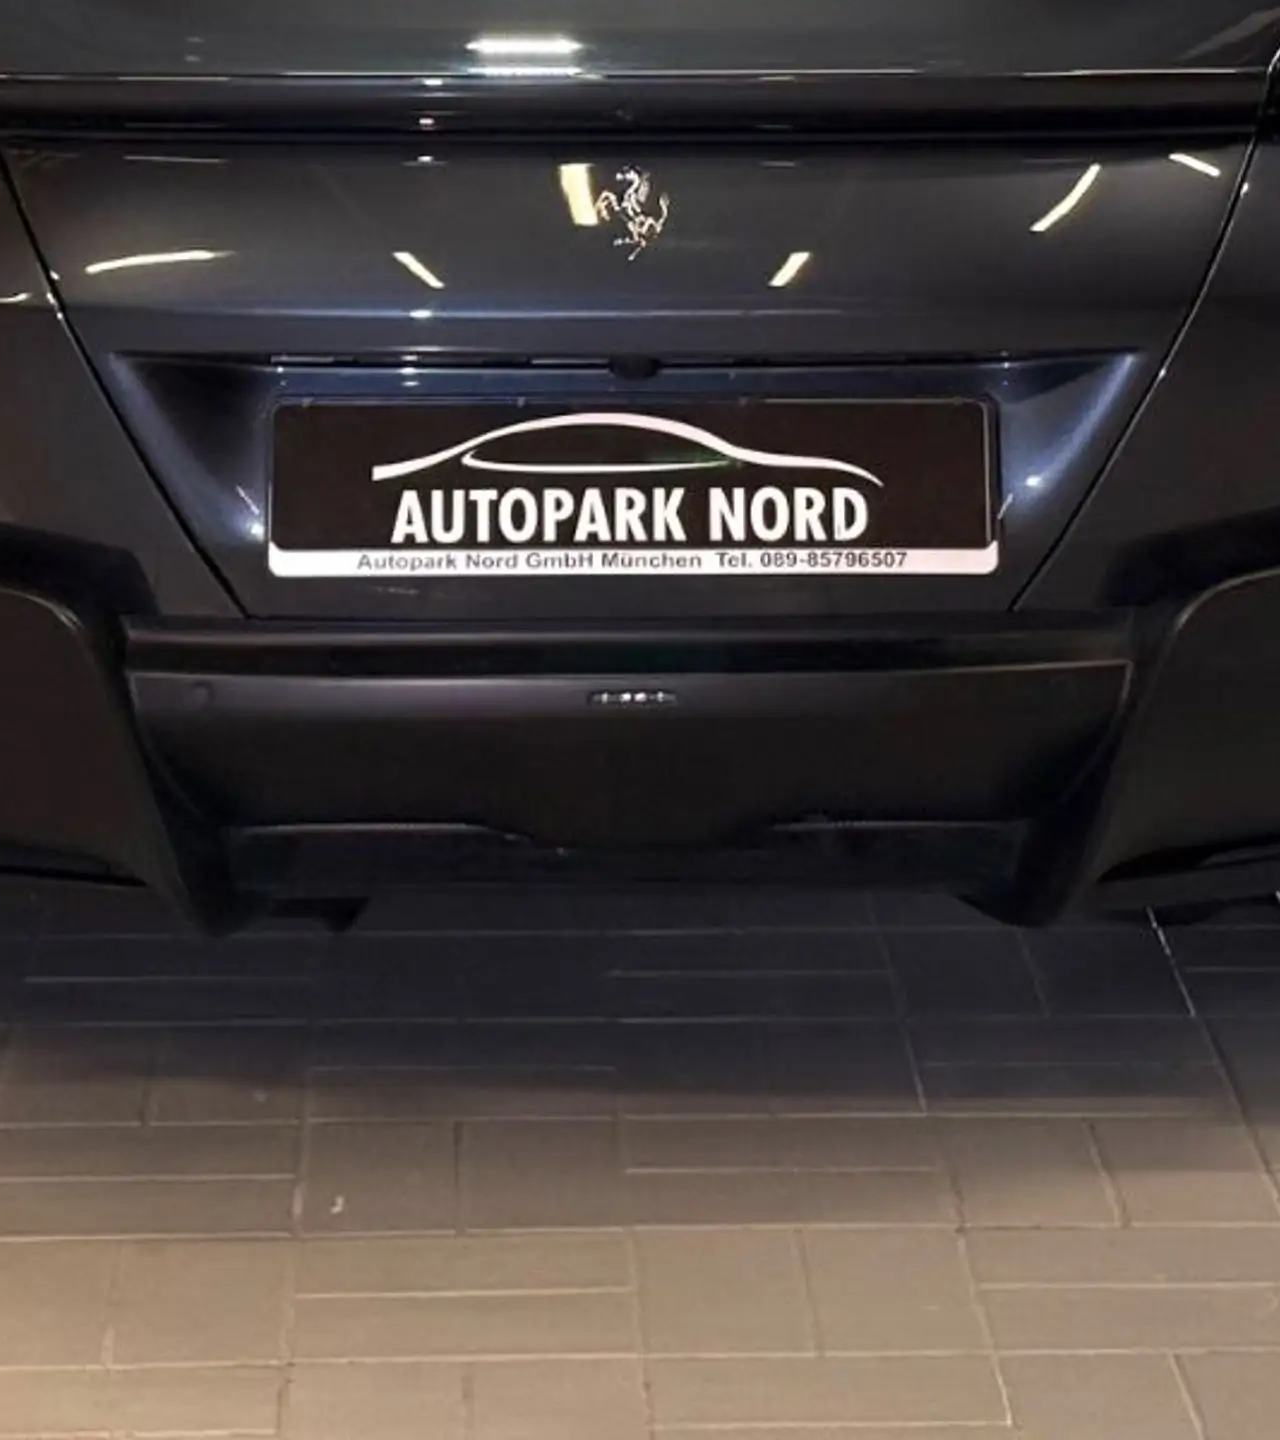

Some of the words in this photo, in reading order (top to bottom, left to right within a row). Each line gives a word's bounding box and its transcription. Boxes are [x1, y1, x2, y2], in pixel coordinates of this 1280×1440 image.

[391, 487, 687, 544] AUTOPARK
[709, 486, 869, 542] NORD
[356, 553, 458, 572] Autopark
[465, 553, 518, 570] Nord
[524, 552, 594, 569] GmbH
[600, 551, 703, 569] München
[715, 551, 753, 568] Tel.
[759, 551, 909, 568] 089-85796507
